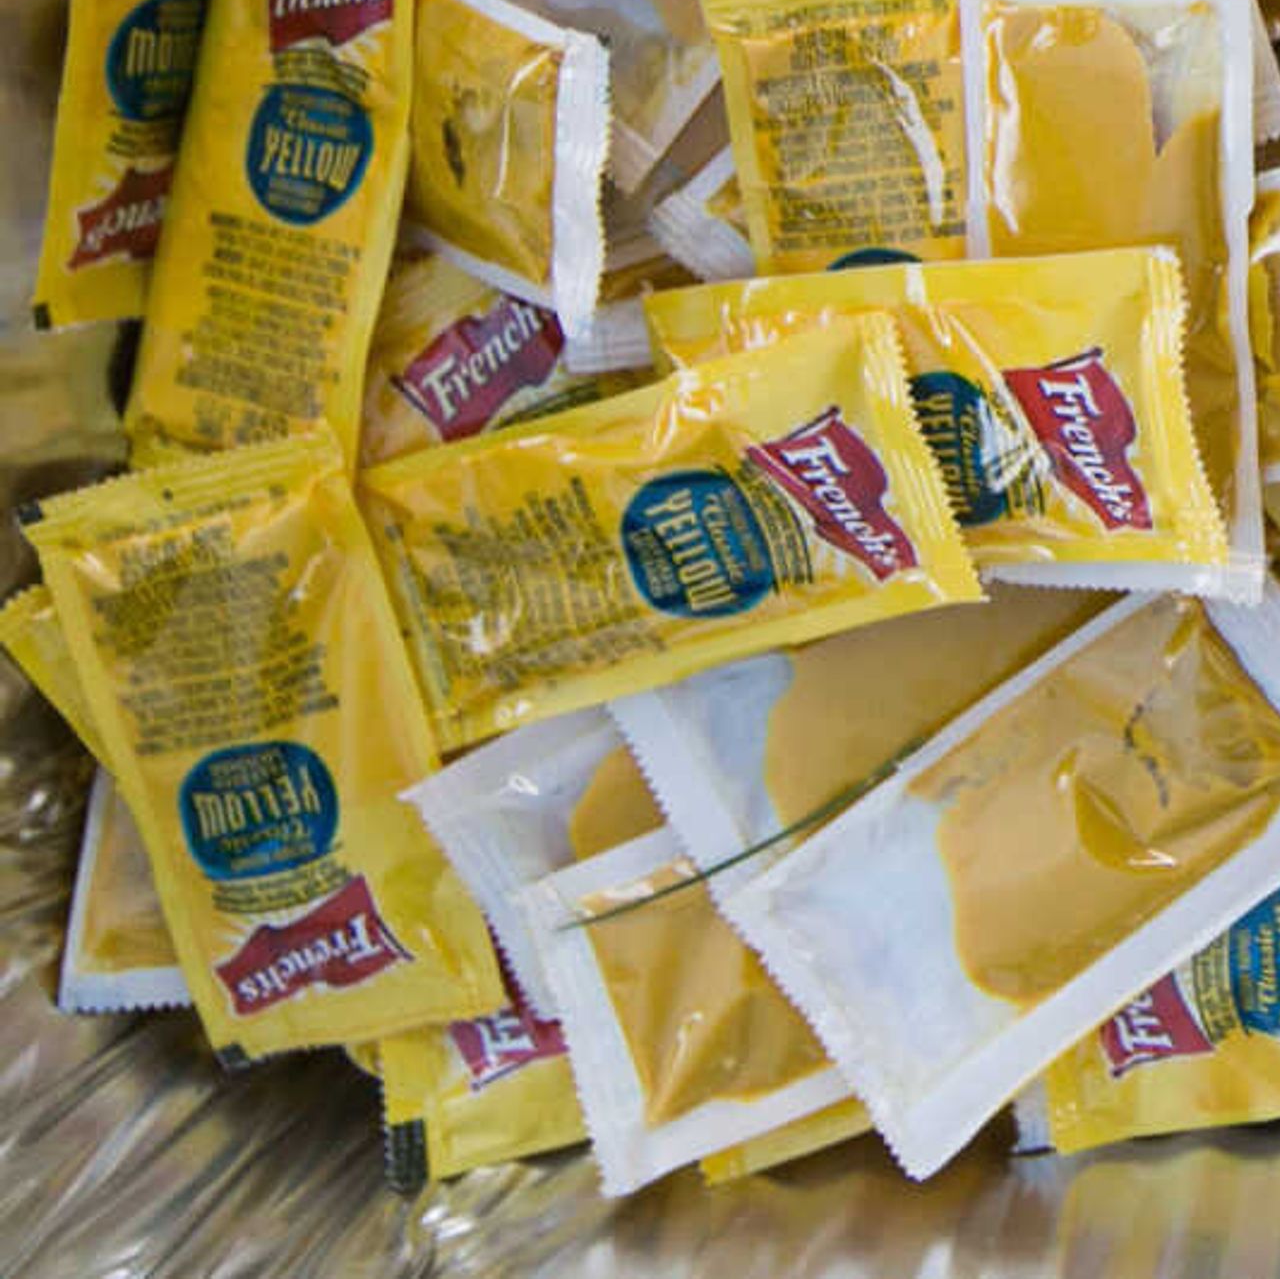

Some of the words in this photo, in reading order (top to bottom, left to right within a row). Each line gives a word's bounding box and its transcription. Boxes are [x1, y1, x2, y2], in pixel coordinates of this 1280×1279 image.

[259, 126, 363, 193] YELLOW
[421, 301, 542, 422] French
[780, 435, 898, 567] French's
[1036, 373, 1134, 522] French's
[645, 488, 736, 611] YELLOW
[191, 763, 321, 842] YELLOW
[236, 913, 386, 1005] French's
